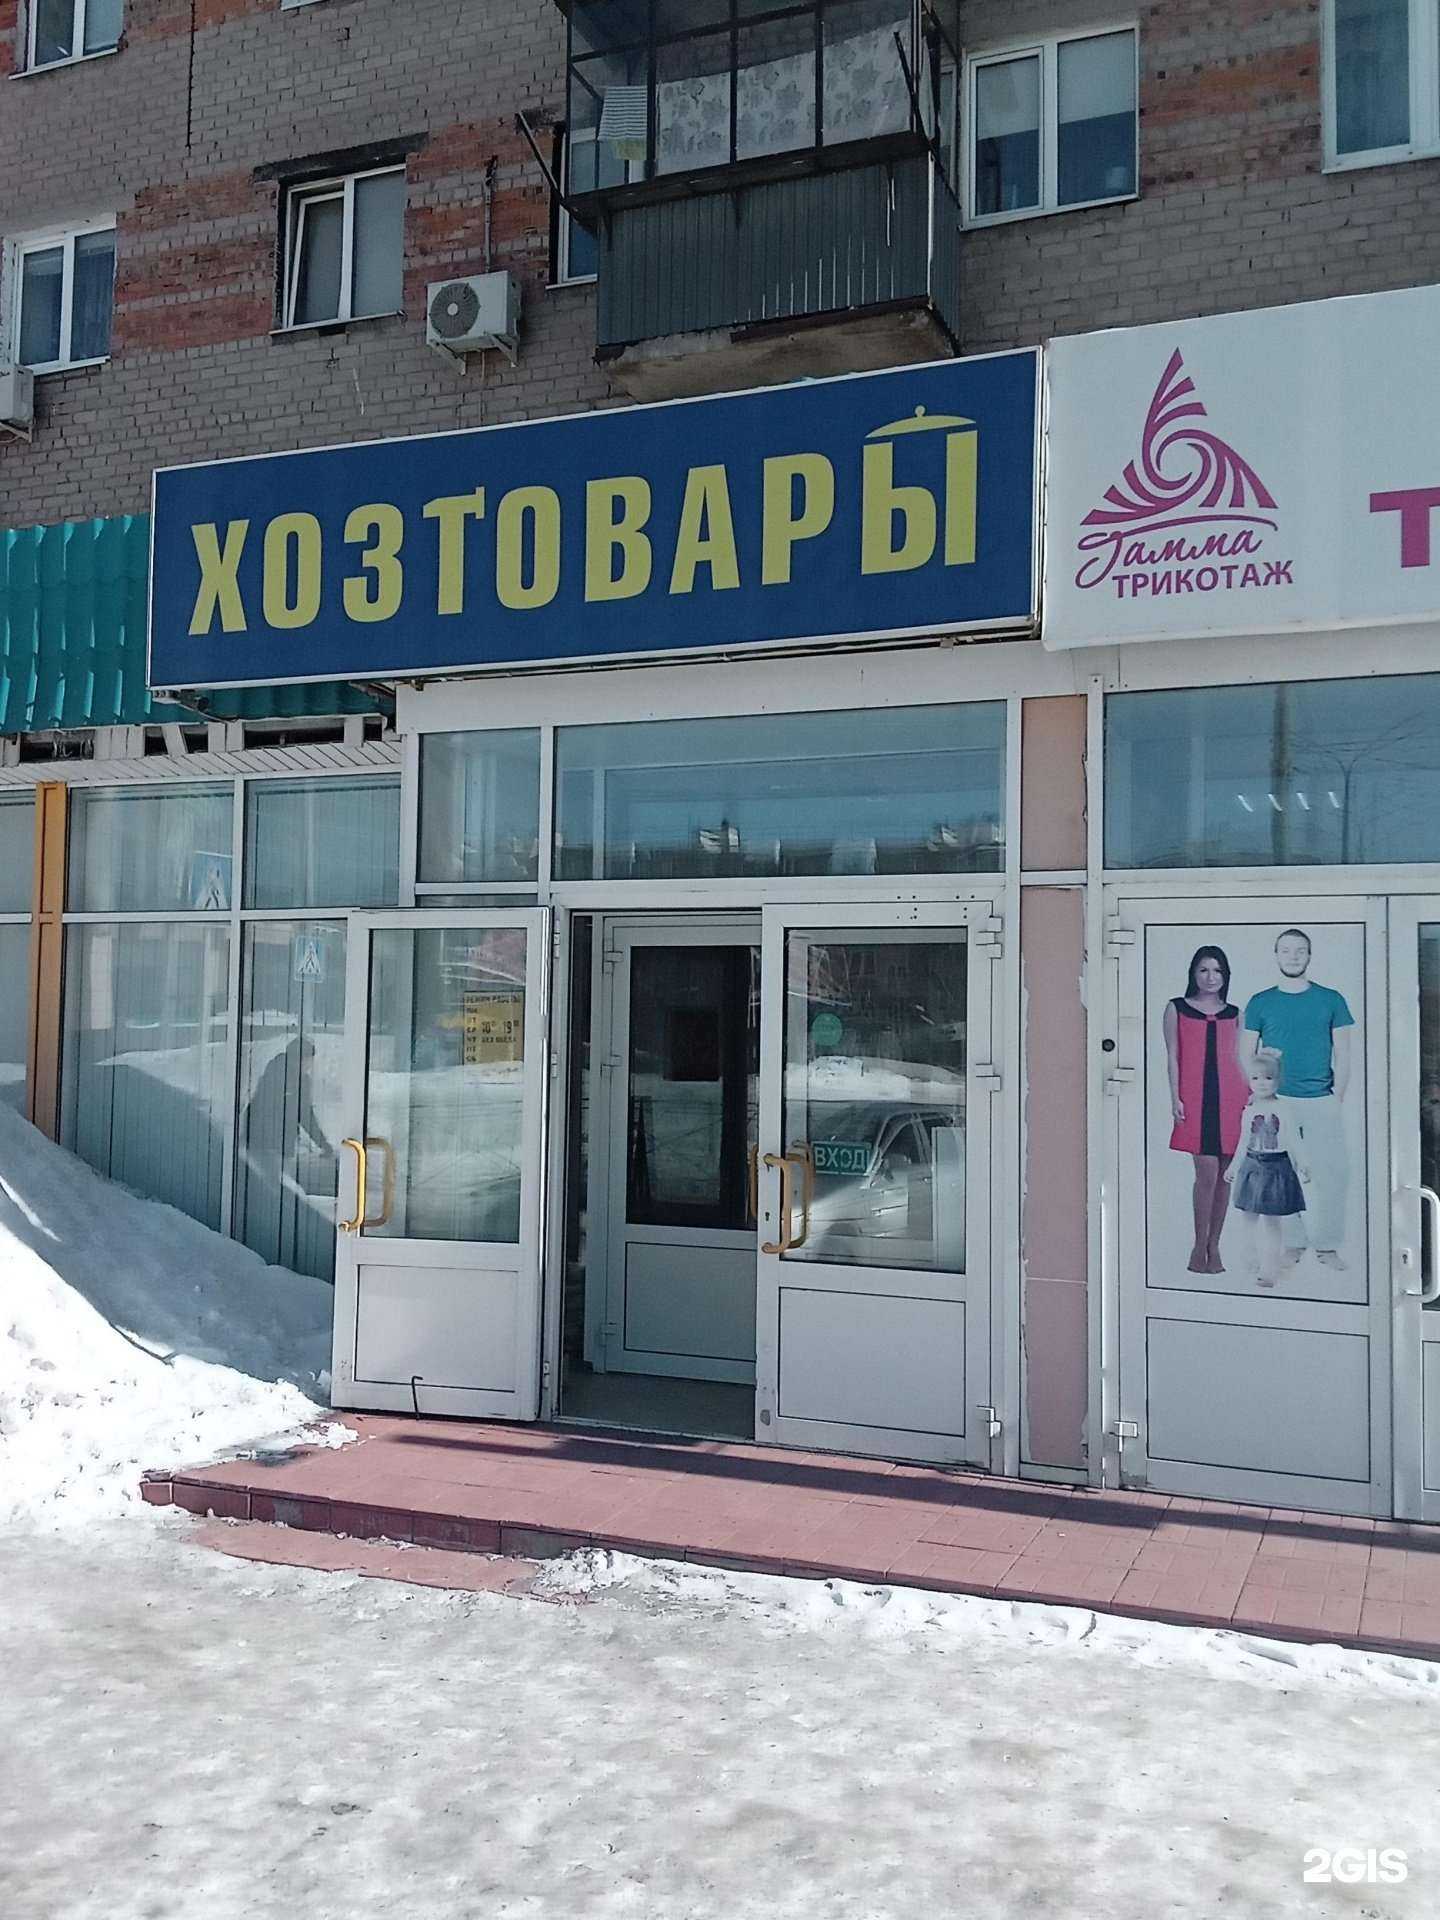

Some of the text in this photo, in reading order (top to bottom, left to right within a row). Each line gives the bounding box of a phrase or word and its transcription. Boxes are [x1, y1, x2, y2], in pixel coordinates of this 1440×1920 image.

[188, 429, 979, 636] ХОЗТОВАРЫ
[1075, 514, 1278, 589] Гамма
[1112, 560, 1293, 598] ТРИКОТАЖ
[815, 1146, 866, 1170] ВХОД
